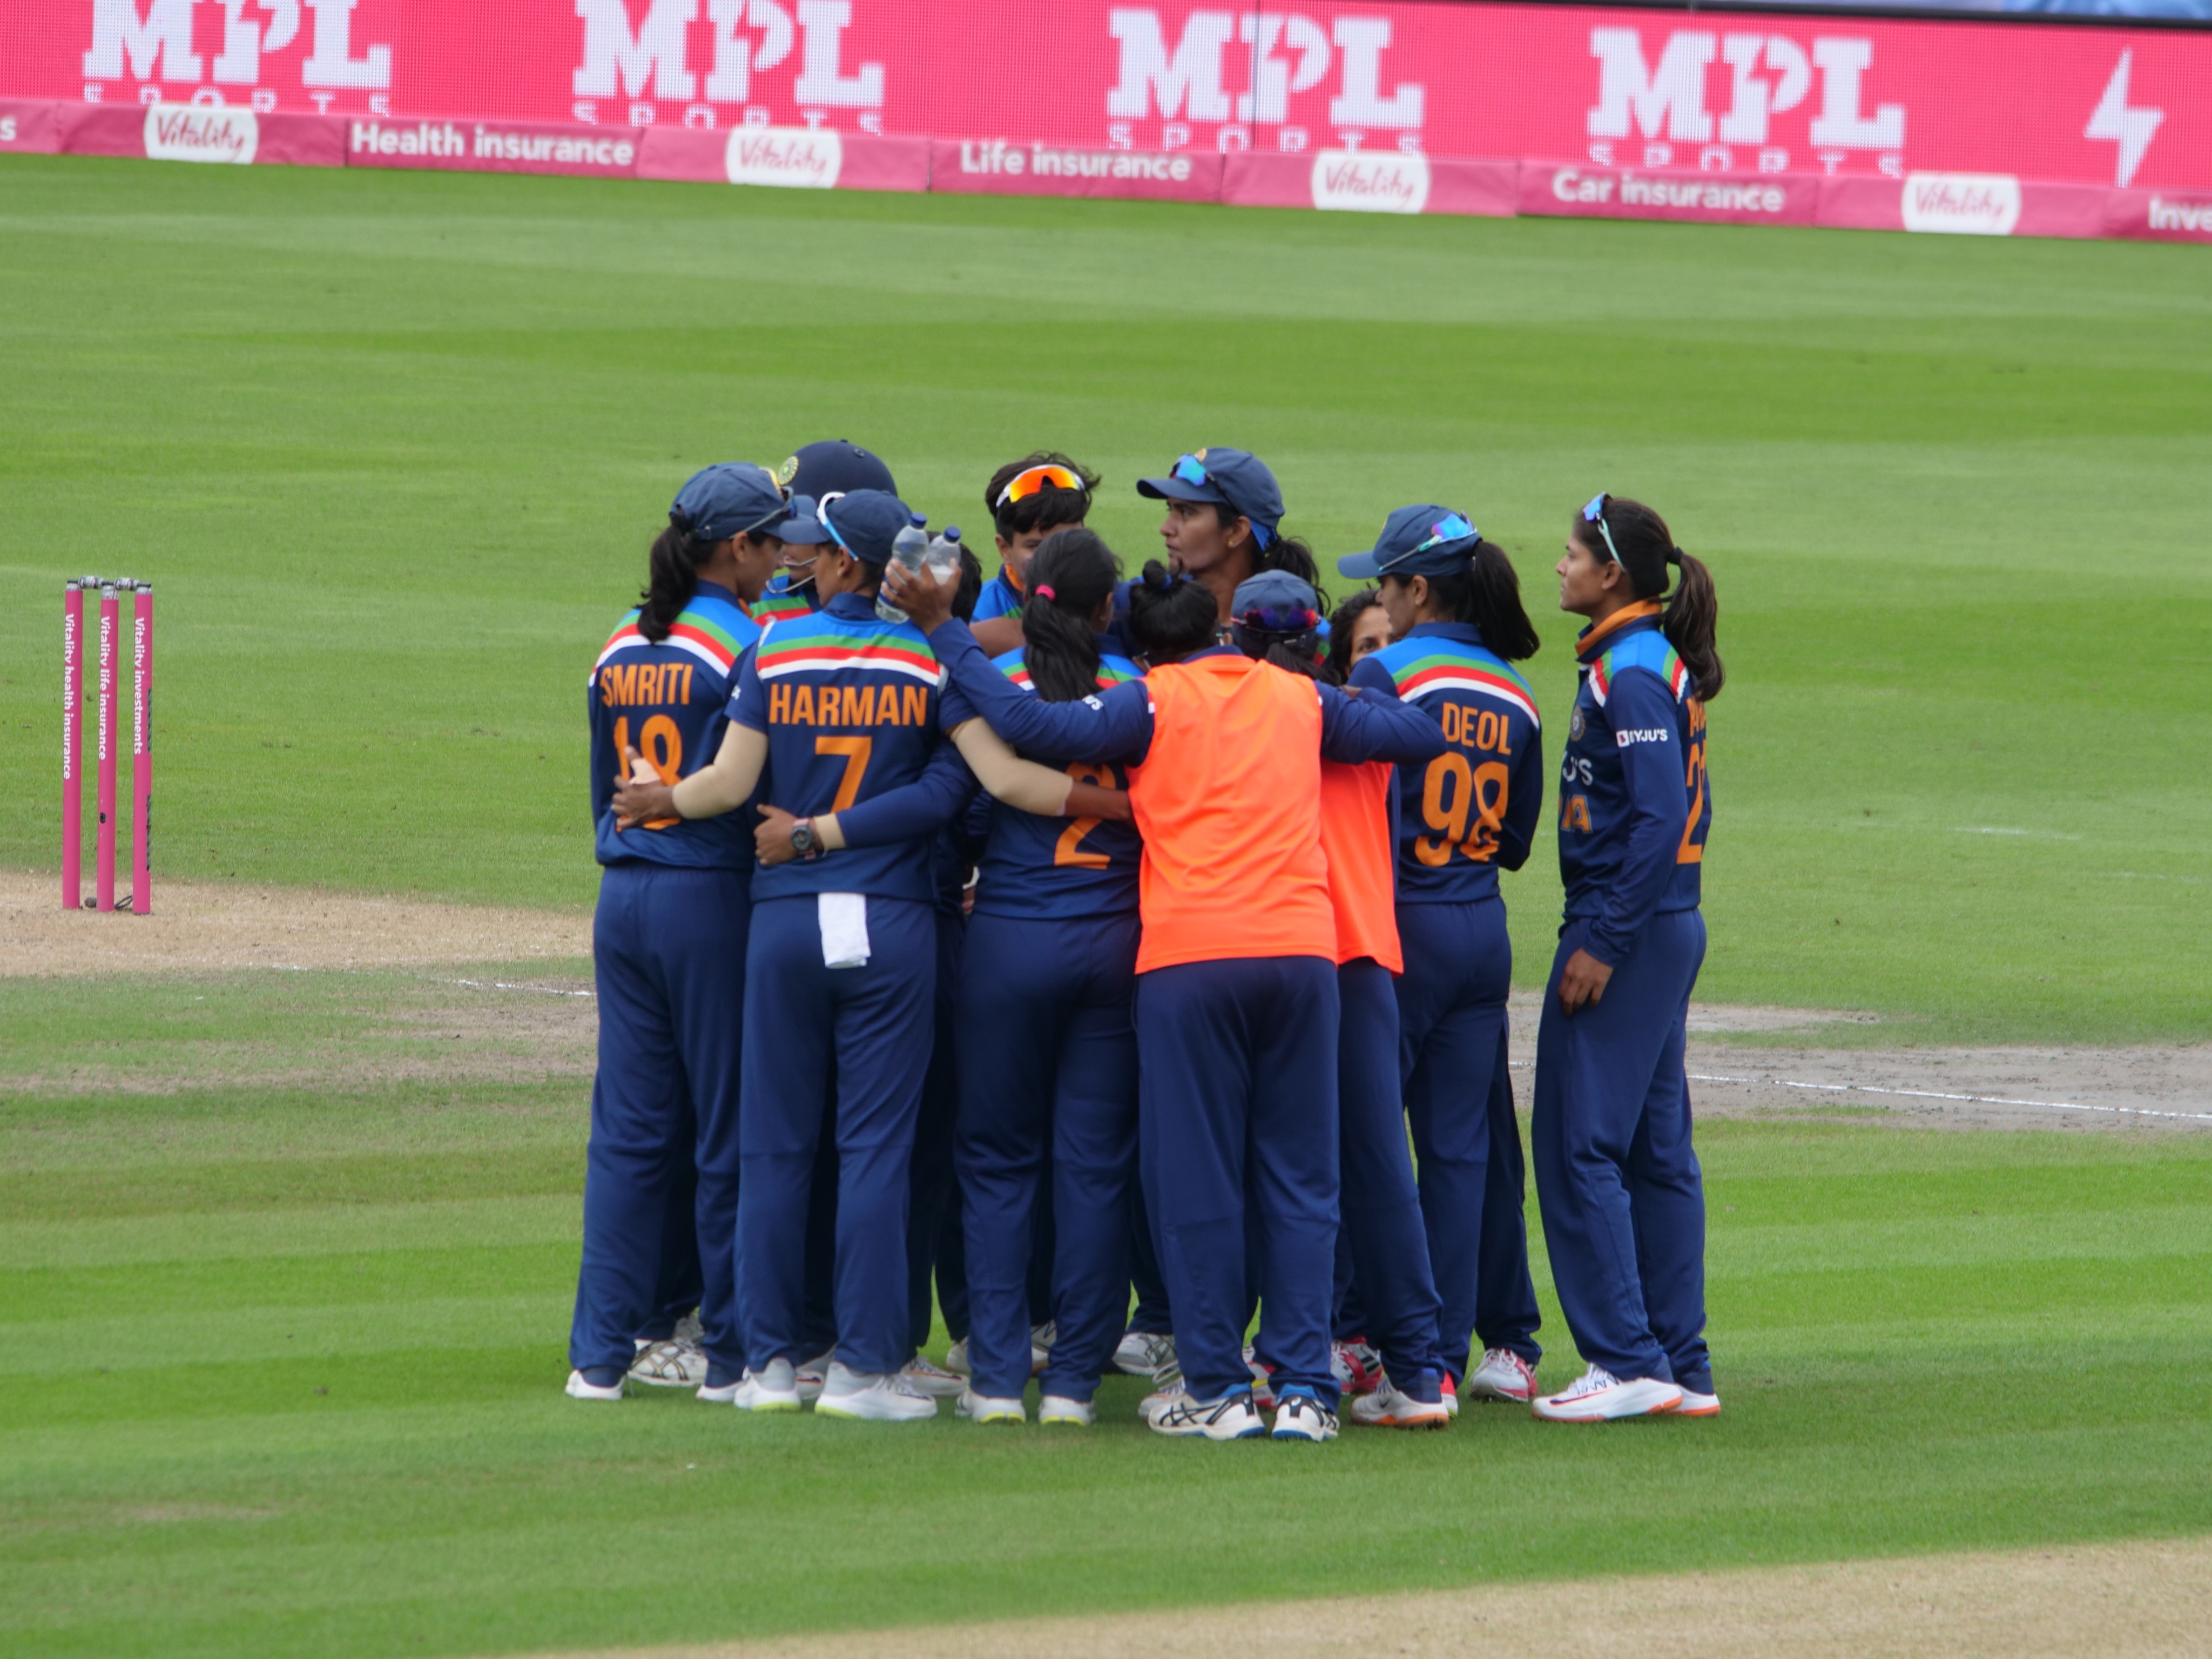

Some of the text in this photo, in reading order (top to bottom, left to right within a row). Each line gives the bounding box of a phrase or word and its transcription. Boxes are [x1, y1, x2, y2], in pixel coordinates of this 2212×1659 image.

[83, 0, 392, 89] MPL
[574, 0, 885, 107] MPL
[1107, 8, 1425, 128] MPL
[1588, 26, 1906, 149] MPL
[157, 110, 245, 163] Vitality
[352, 122, 634, 166] Health insurance
[740, 134, 827, 185] Vitality
[961, 141, 1191, 181] Life insurance
[1326, 160, 1414, 211] Vitality
[1553, 170, 1784, 212] Car insurance
[1916, 181, 2004, 232] Vitality
[63, 613, 75, 779] Vitality health insurance
[98, 616, 111, 760] Vitality life insurance
[134, 617, 145, 755] Vitality investments
[599, 663, 694, 707] SMRITI
[768, 684, 928, 726] HARMAN
[1442, 702, 1512, 756] DEOL
[815, 736, 872, 814] 7
[1415, 751, 1509, 867] 98
